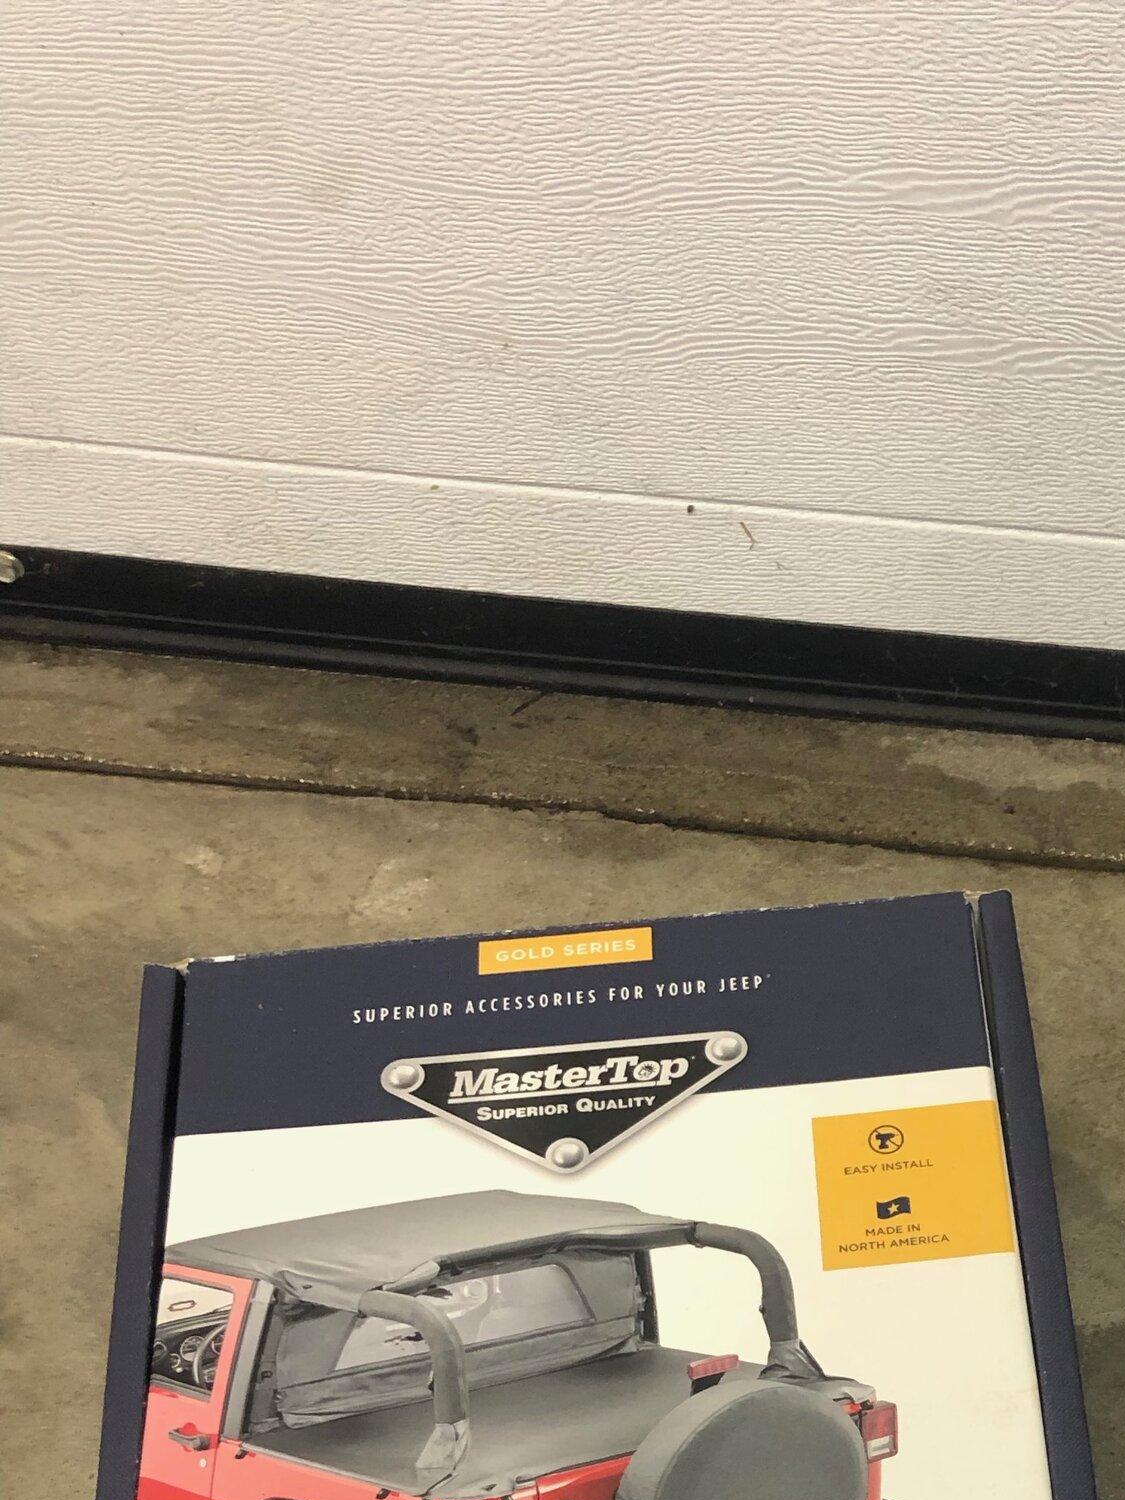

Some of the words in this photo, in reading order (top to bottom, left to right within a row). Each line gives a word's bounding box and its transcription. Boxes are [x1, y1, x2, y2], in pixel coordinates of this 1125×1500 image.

[495, 945, 555, 963] GOLD
[563, 939, 637, 957] SERIES
[352, 1002, 453, 1024] SUPERIOR
[465, 989, 597, 1014] ACCESSORIES
[609, 986, 645, 1001] FOR
[656, 979, 707, 997] YOUR
[448, 1054, 690, 1100] MasterTop
[477, 1102, 569, 1121] SUPERIOR
[576, 1095, 656, 1113] QUALITY
[844, 1163, 877, 1176] EASY
[881, 1159, 934, 1172] INSTALL
[865, 1225, 903, 1237] MADE
[907, 1223, 921, 1233] IN
[838, 1241, 886, 1253] NORTH
[890, 1233, 950, 1248] AMERICA
